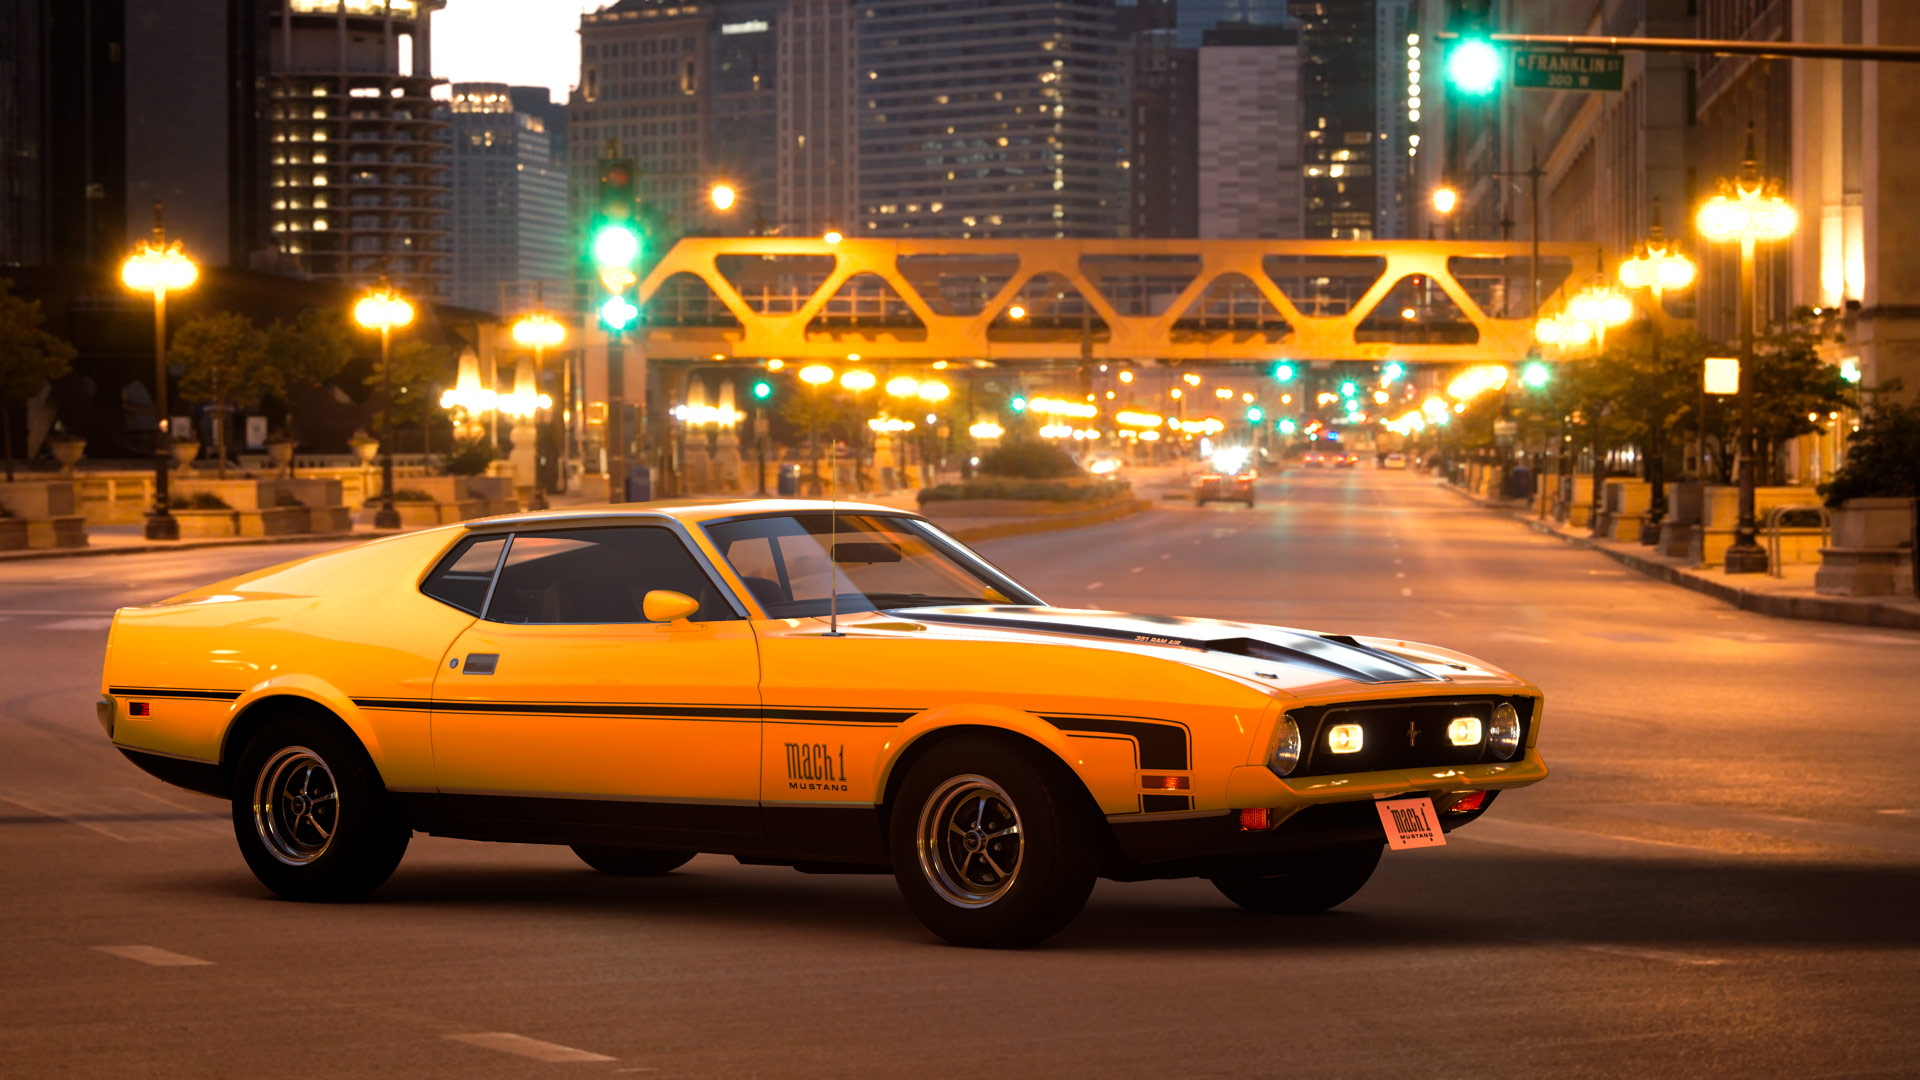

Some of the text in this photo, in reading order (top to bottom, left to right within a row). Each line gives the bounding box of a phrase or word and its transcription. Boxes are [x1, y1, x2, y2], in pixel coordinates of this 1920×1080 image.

[1528, 54, 1605, 72] FRANKLIN
[1548, 75, 1573, 86] 300
[785, 742, 847, 781] mach 1
[789, 782, 848, 791] MUSTANG
[1390, 807, 1431, 833] mach 1
